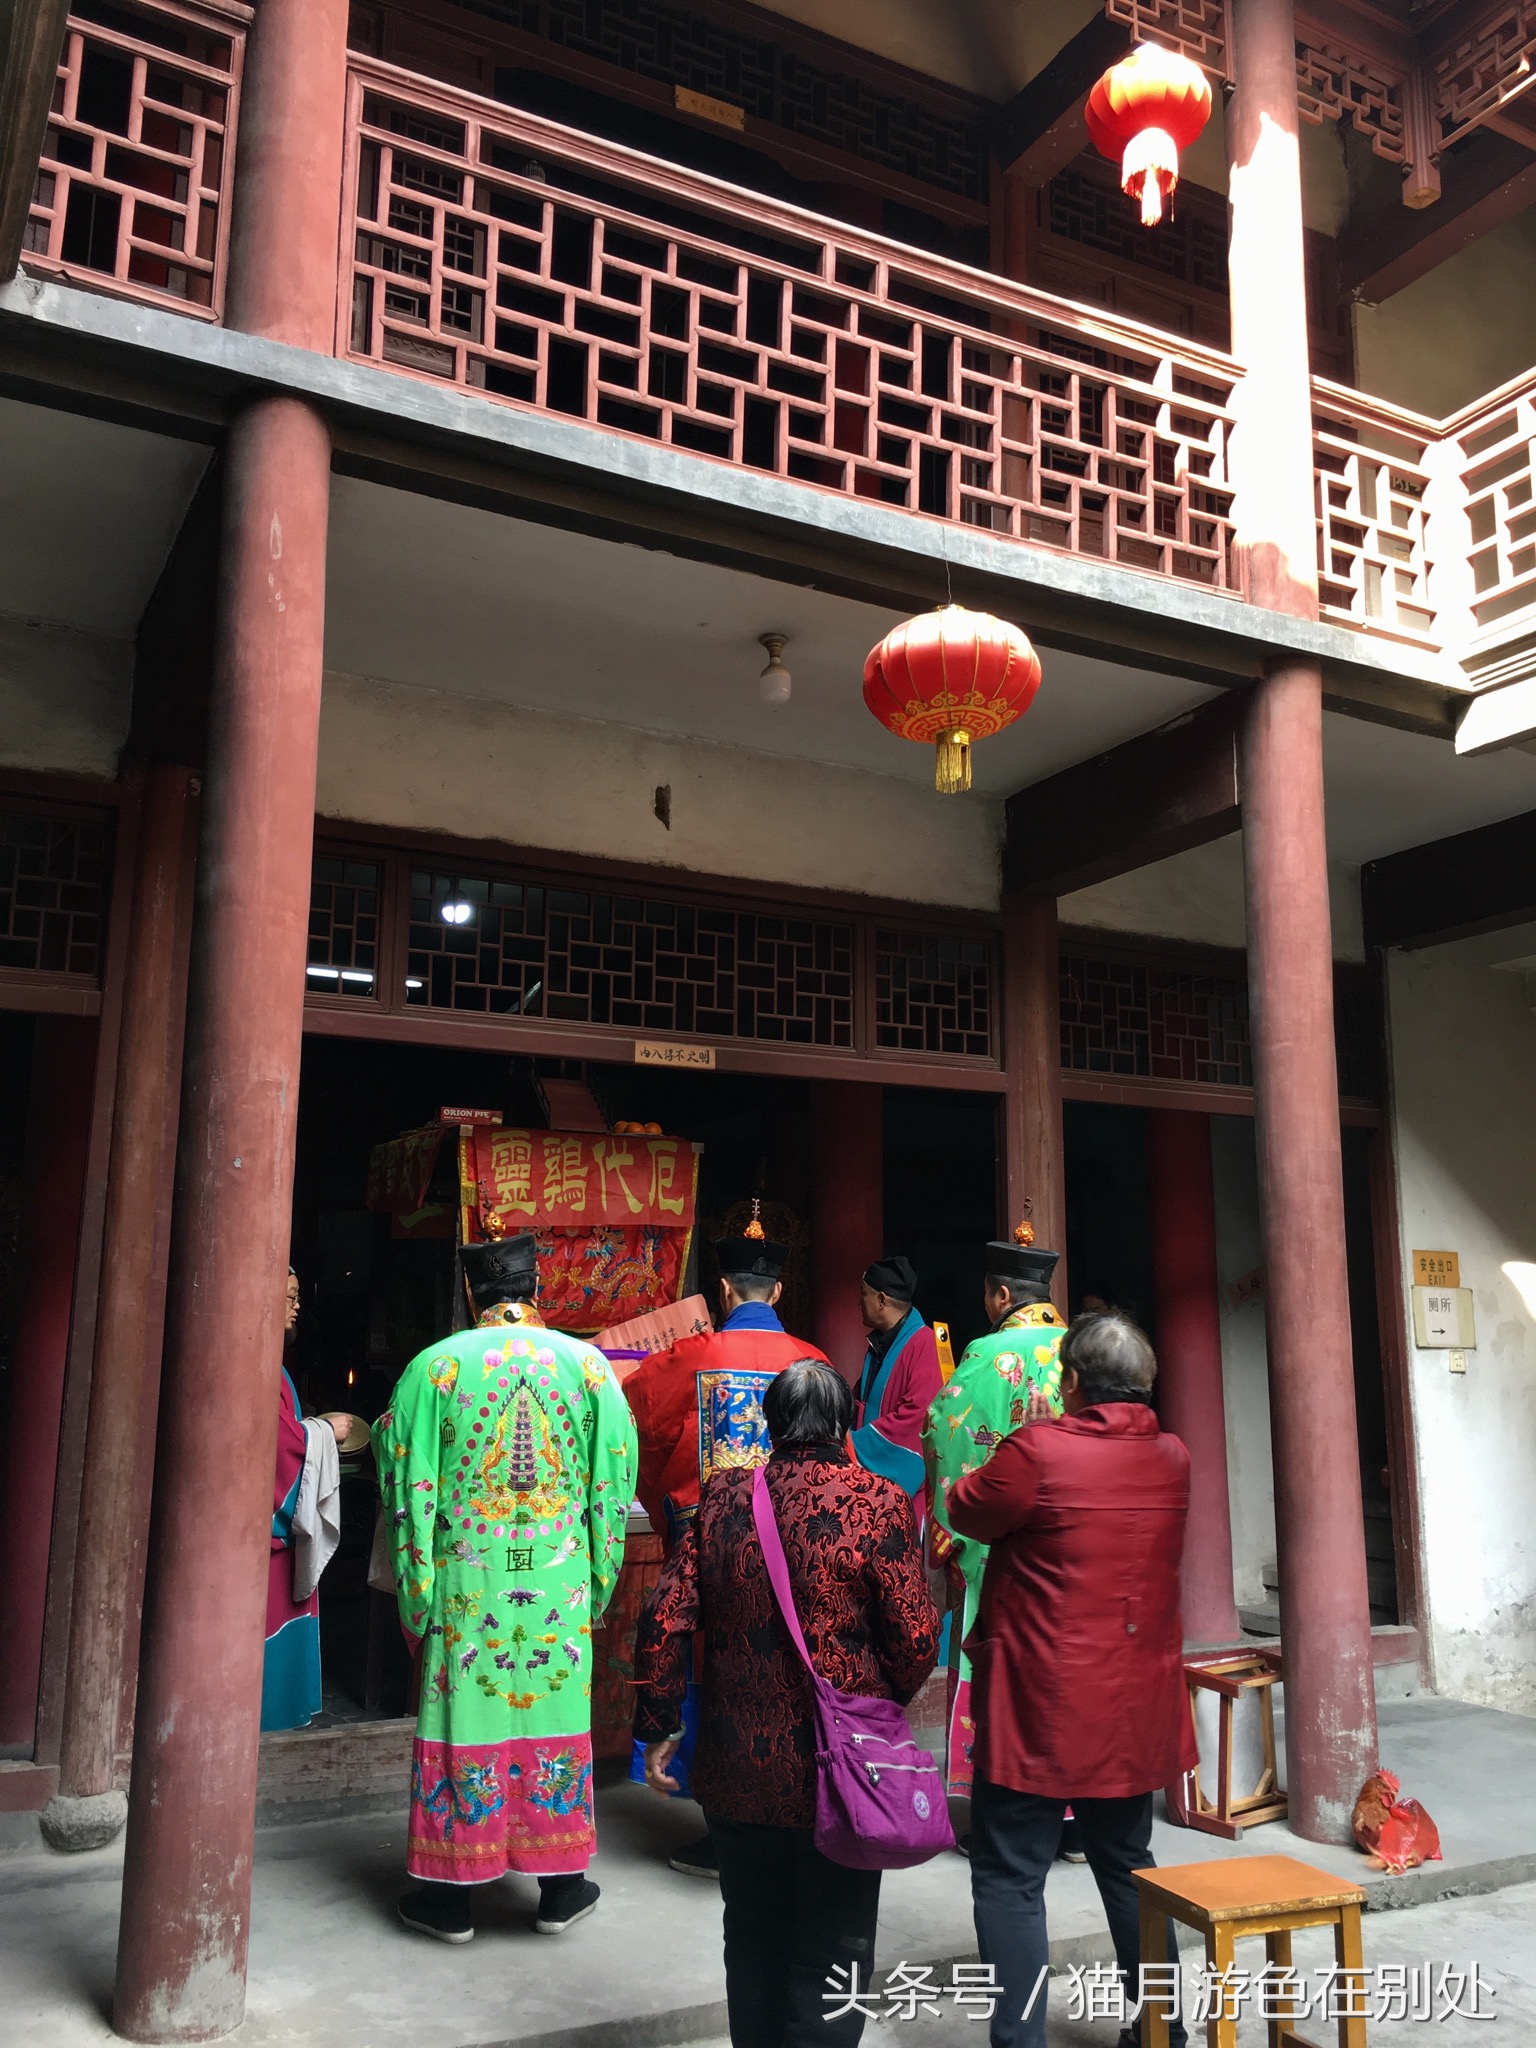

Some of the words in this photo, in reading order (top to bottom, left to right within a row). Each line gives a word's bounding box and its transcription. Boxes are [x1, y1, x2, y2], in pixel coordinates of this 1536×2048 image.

[443, 1109, 473, 1117] ORION
[1420, 1258, 1453, 1272] 安全出口
[1428, 1274, 1446, 1285] EXIT
[1428, 1297, 1451, 1312] 厕所
